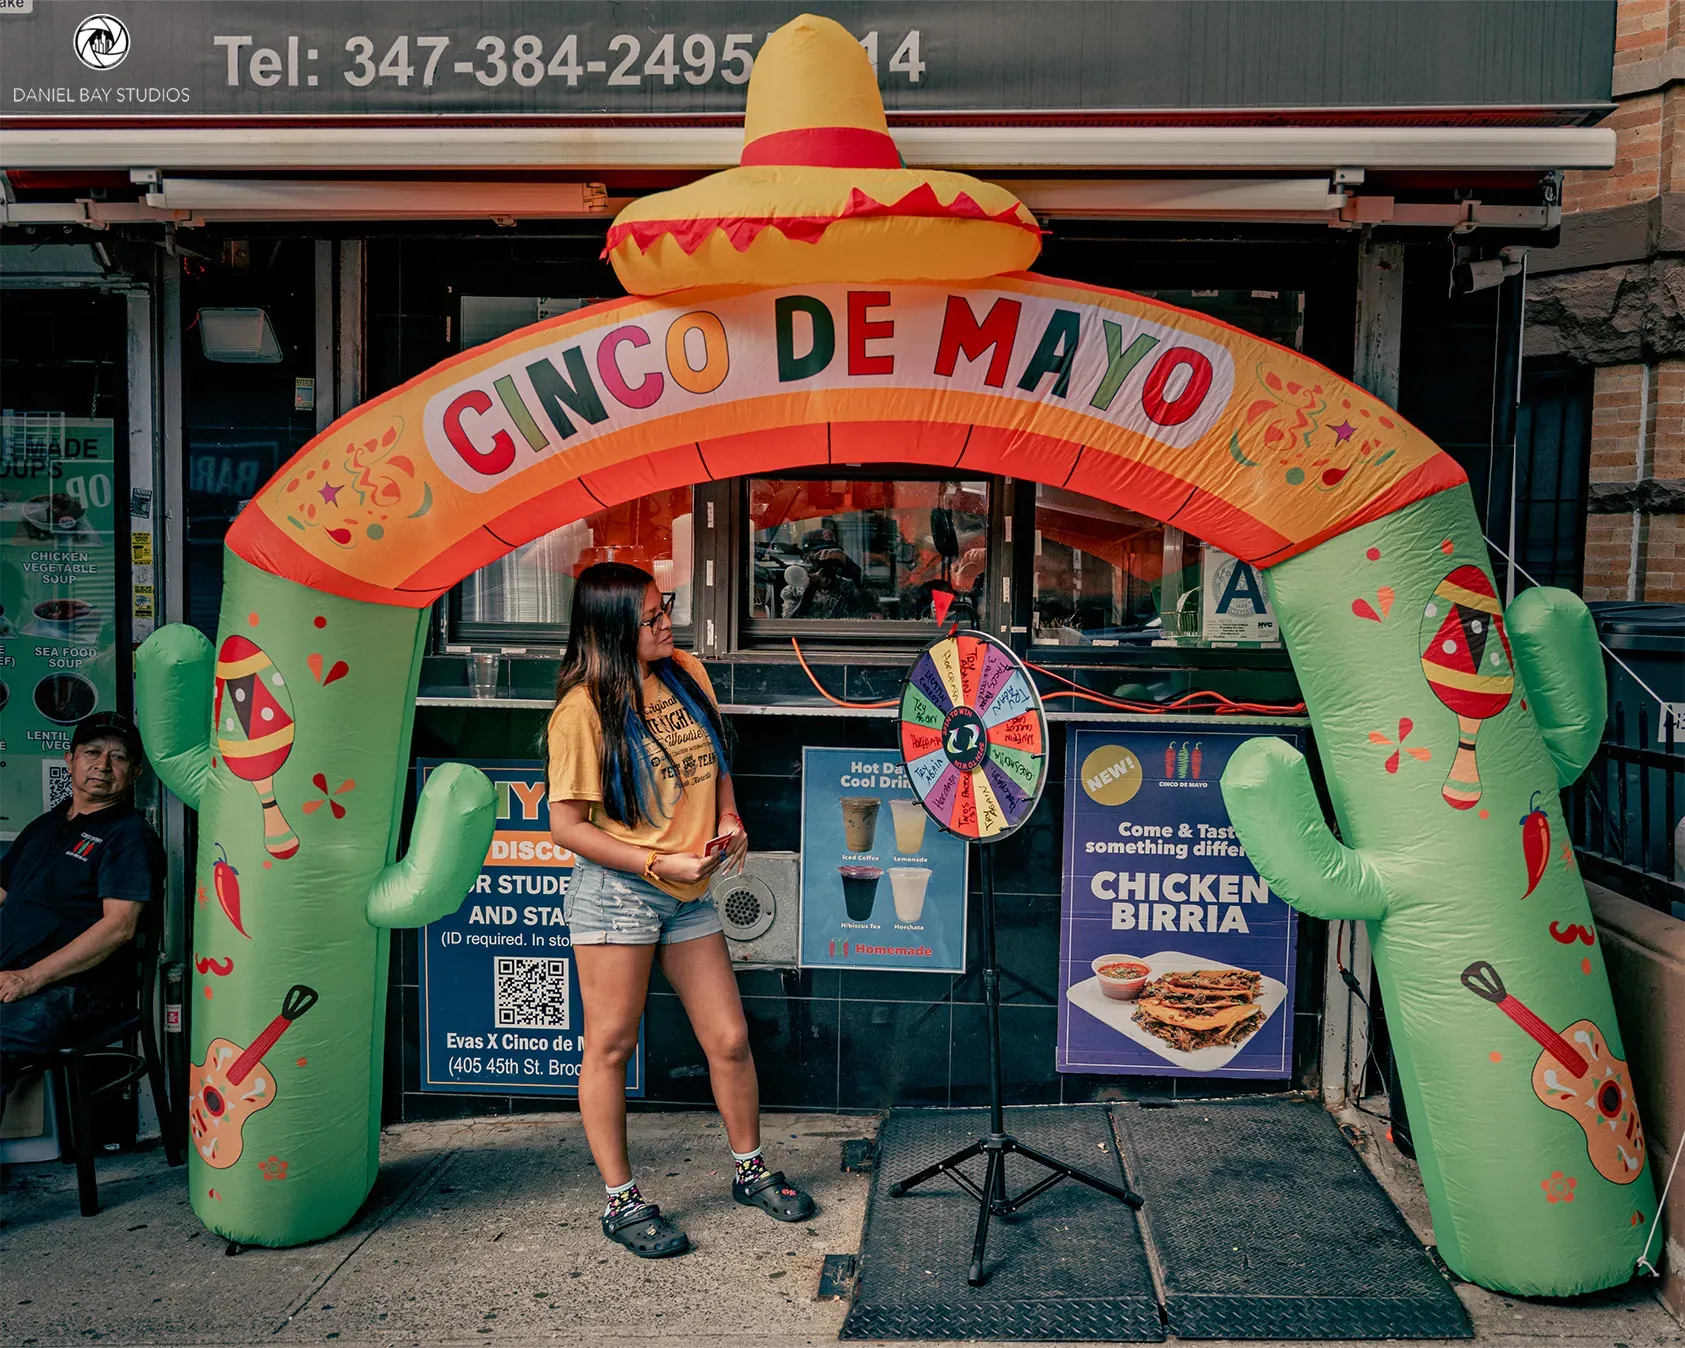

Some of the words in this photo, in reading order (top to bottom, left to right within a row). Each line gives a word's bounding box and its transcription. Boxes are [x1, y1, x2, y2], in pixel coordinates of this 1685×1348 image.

[213, 35, 319, 87] Tel:
[443, 310, 730, 476] CINCO
[775, 290, 895, 383] DE
[933, 294, 1213, 427] MAYO
[30, 551, 88, 562] CHICKEN
[22, 562, 97, 574] VEGETABLE
[42, 574, 77, 584] SOUP
[1215, 559, 1268, 615] A
[34, 646, 62, 657] SEA
[63, 647, 98, 658] FOOD
[48, 658, 84, 668] SOUP
[942, 716, 952, 736] SPIN
[950, 709, 958, 718] TO
[959, 708, 973, 718] WIN
[26, 730, 70, 742] LENTIL
[851, 762, 879, 774] Hot
[1086, 756, 1136, 793] NEW!
[840, 775, 876, 788] Cool
[1118, 822, 1174, 838] Come
[1178, 823, 1194, 838] &
[1196, 824, 1239, 840] Tast
[1085, 840, 1188, 860] something
[1090, 870, 1269, 904] CHICKEN
[468, 906, 518, 926] AND
[1112, 902, 1250, 934] BIRRIA
[441, 932, 462, 949] (ID
[466, 933, 527, 950] required.
[532, 934, 544, 947] In
[856, 944, 933, 956] Homemade
[446, 1032, 484, 1050] Evas
[486, 1033, 498, 1049] X
[502, 1033, 549, 1051] Cinco
[552, 1034, 573, 1052] de
[448, 1057, 482, 1076] (405
[486, 1056, 519, 1076] 45th
[524, 1057, 544, 1076] St.
